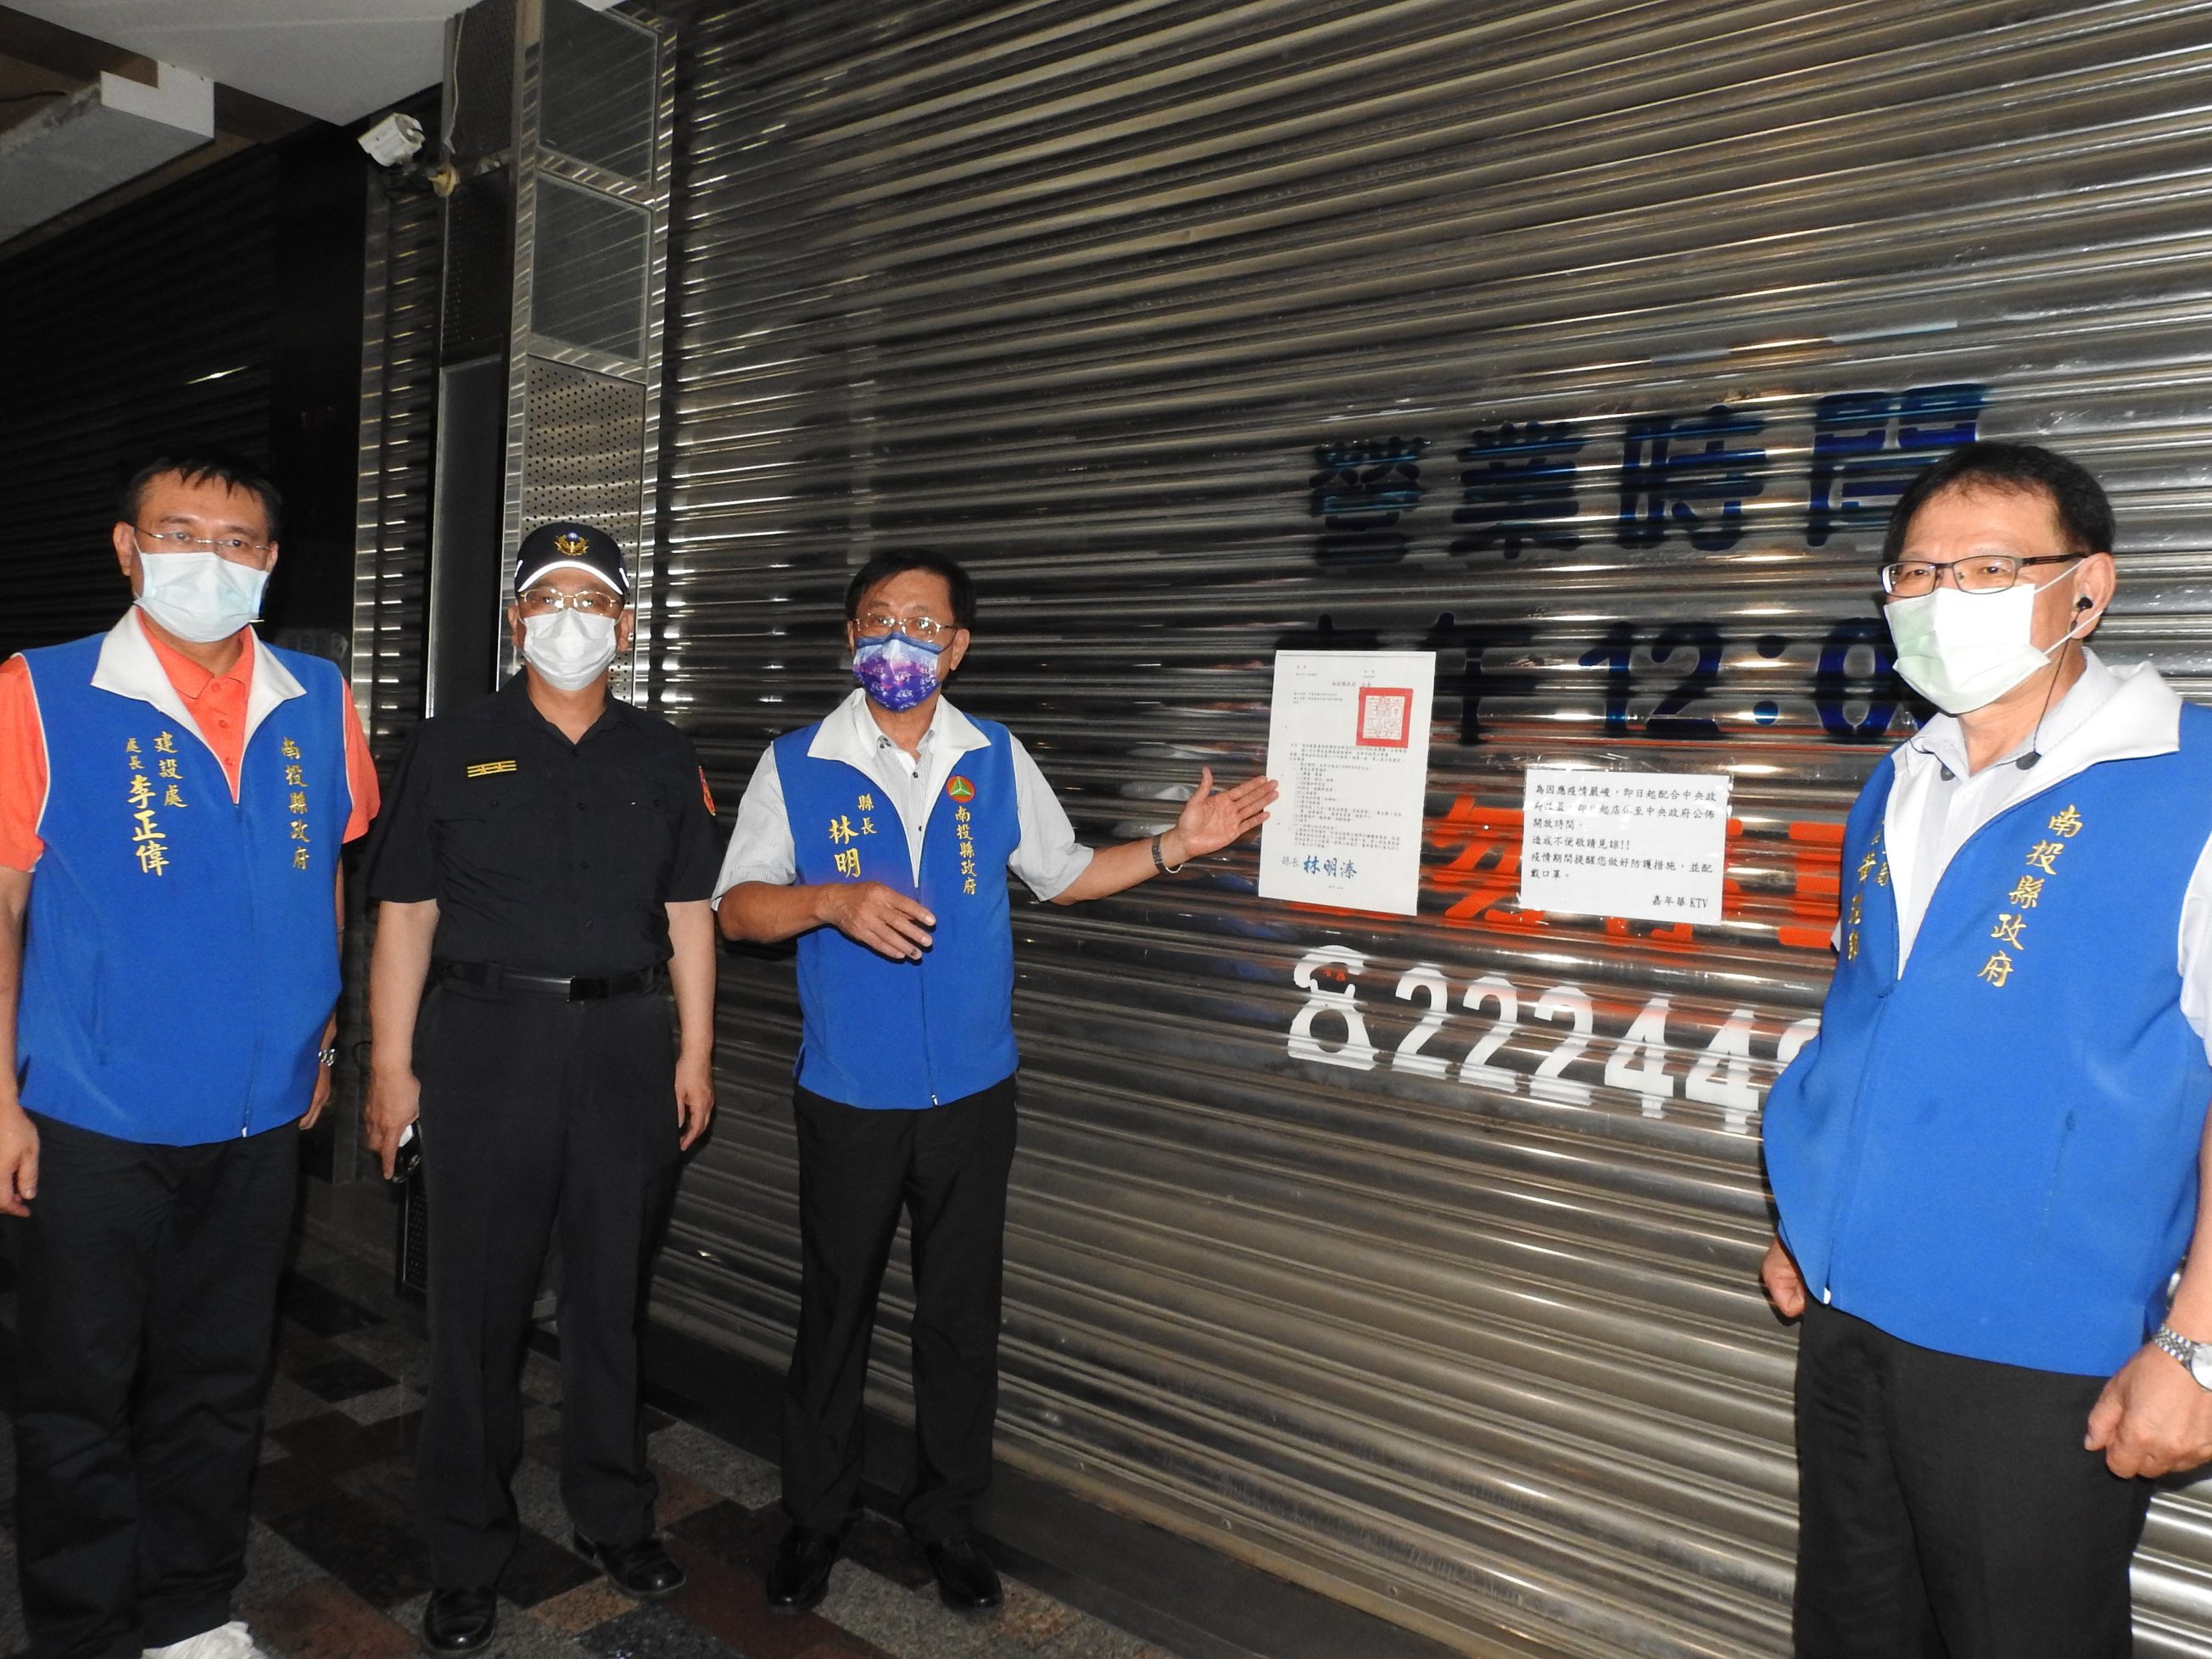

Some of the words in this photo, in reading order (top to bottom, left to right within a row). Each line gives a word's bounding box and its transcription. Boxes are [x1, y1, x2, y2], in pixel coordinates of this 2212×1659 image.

[1274, 612, 1539, 746] 午
[1577, 616, 1941, 746] 12:0
[153, 730, 188, 807] 建設處
[281, 737, 310, 870] 南投縣政府
[127, 774, 170, 876] 李正偉
[828, 815, 862, 879] 林明
[857, 794, 878, 835] 縣長
[954, 806, 978, 896] 南投縣政府
[1689, 897, 1709, 908] KTV
[1977, 804, 2085, 988] 南投縣政府
